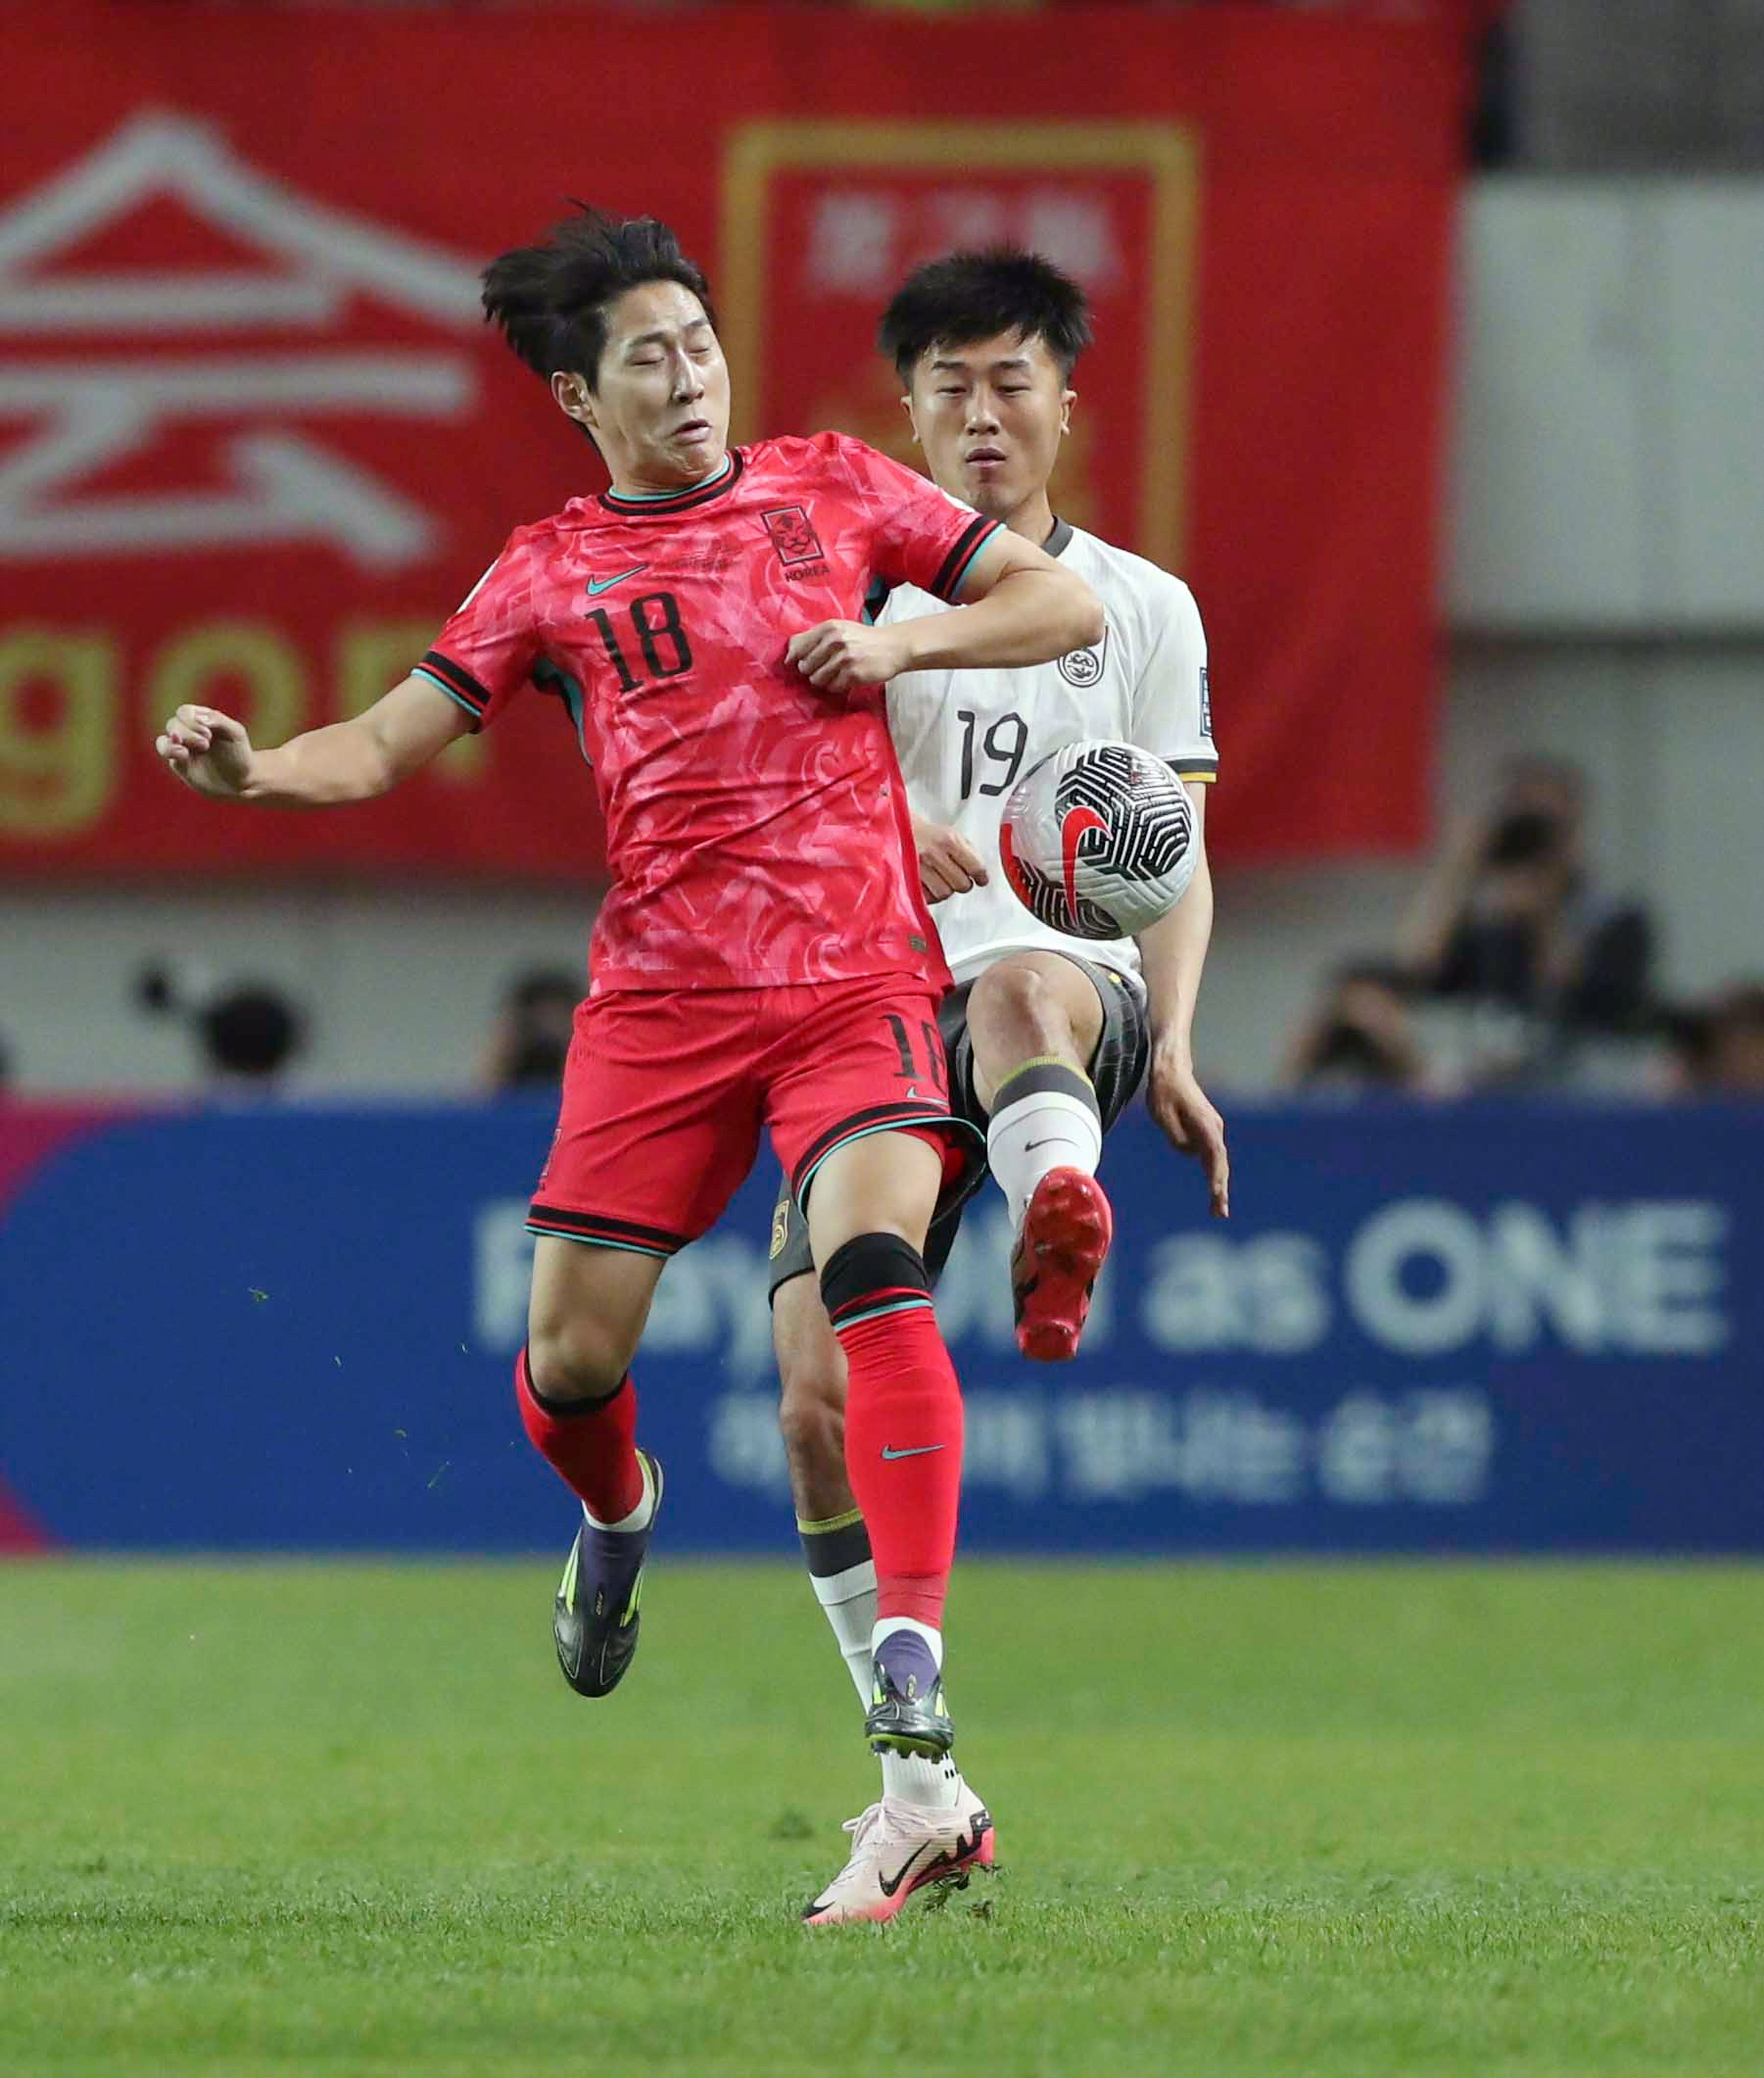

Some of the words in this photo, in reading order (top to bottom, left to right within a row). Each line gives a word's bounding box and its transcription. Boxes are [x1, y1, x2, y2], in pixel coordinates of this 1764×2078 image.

[585, 592, 693, 692] 18
[957, 710, 1028, 800] 19
[1146, 1230, 1331, 1354] as
[1344, 1196, 1730, 1358] ONE
